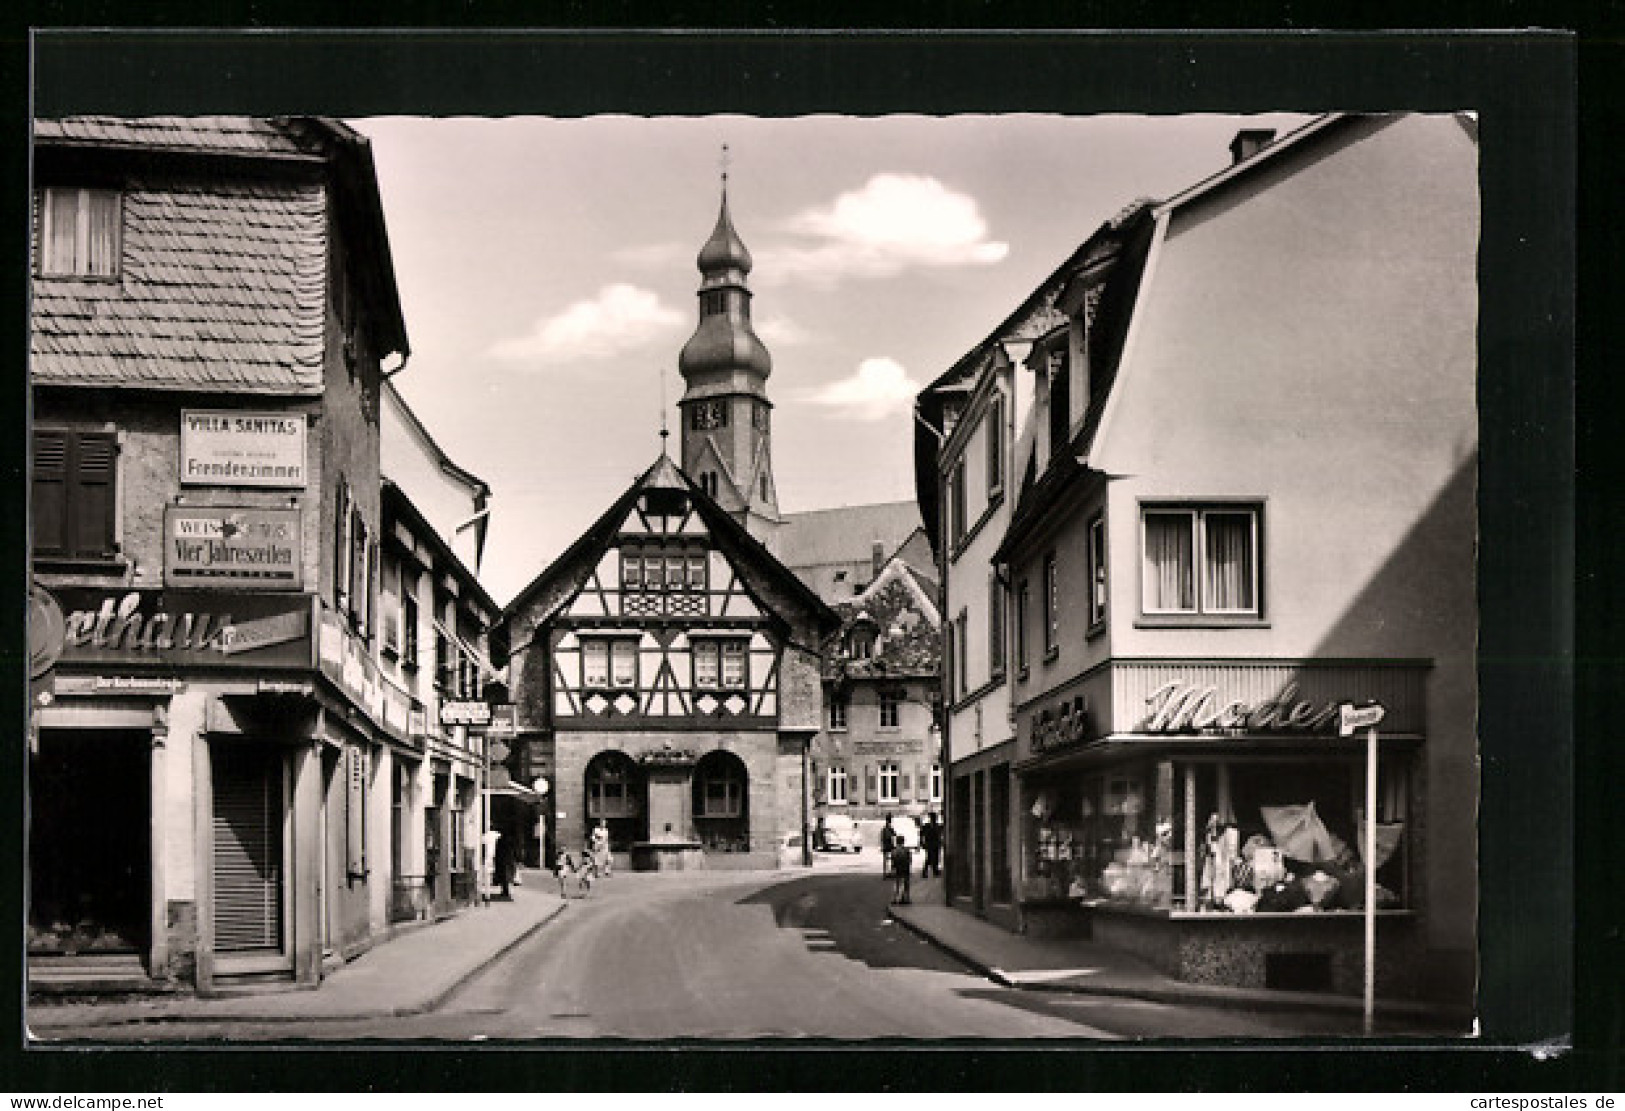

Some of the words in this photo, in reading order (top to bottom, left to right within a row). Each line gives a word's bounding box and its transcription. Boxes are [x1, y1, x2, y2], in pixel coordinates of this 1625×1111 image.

[188, 417, 229, 432] VILLA
[235, 418, 297, 435] SANITAS
[188, 458, 300, 478] Fremdenzimmer
